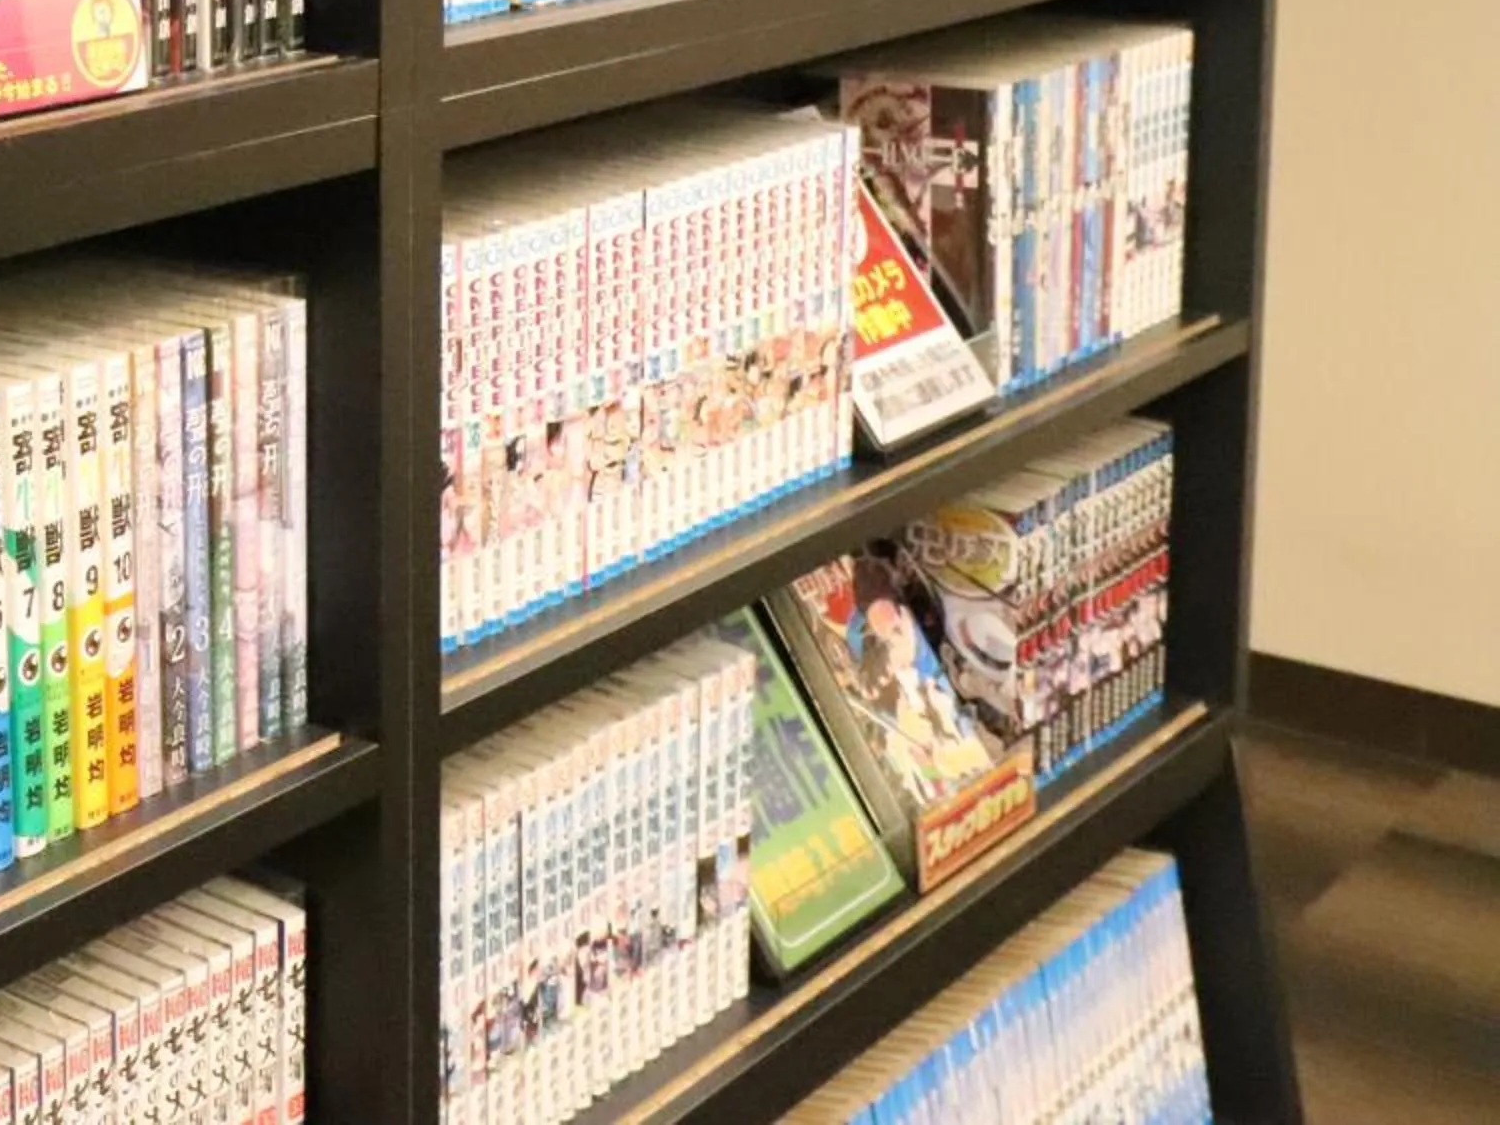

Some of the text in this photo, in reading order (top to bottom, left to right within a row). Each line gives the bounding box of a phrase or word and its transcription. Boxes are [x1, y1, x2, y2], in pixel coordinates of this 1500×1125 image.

[86, 565, 98, 595] 9
[114, 552, 130, 584] 10
[24, 587, 35, 618] 7
[52, 581, 64, 611] 8
[169, 622, 186, 662] 2
